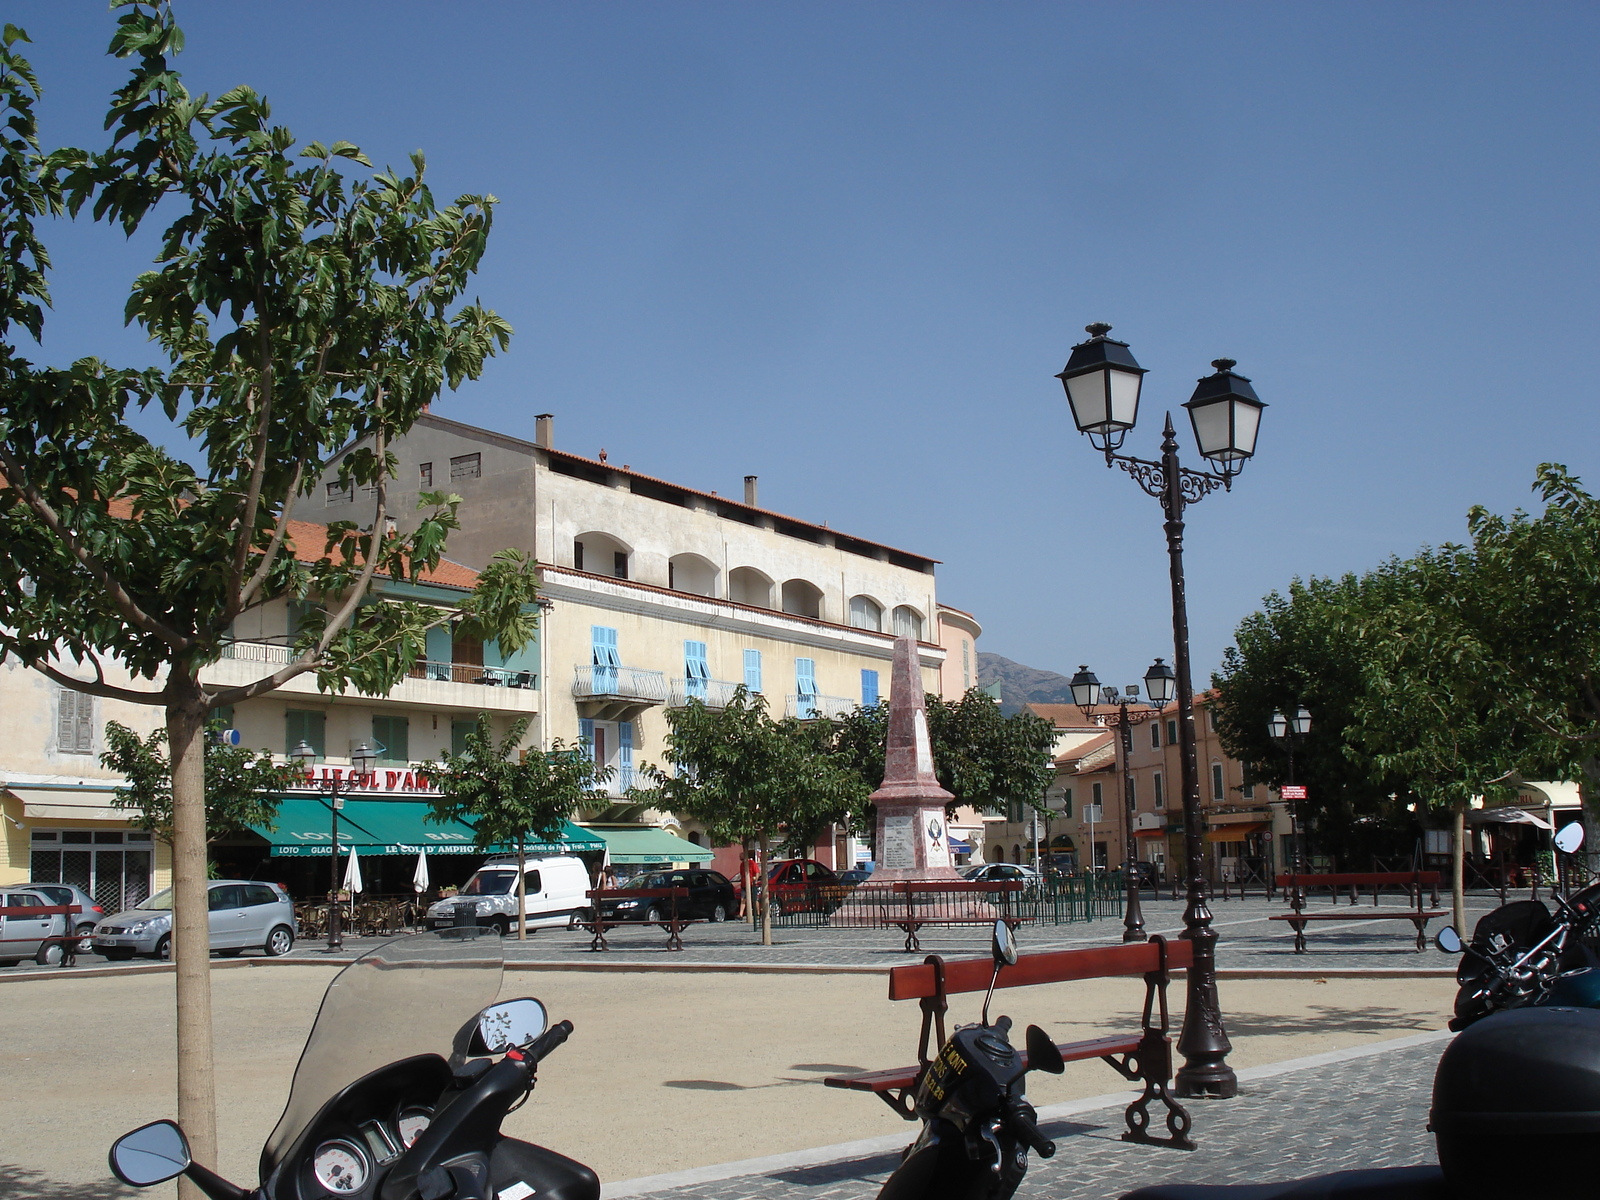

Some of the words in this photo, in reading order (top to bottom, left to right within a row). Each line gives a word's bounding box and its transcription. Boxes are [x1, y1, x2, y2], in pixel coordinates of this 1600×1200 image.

[291, 832, 353, 841] LOTO
[424, 832, 470, 841] BAR
[279, 846, 300, 854] LOTO
[385, 845, 398, 853] LE
[400, 845, 420, 853] COL
